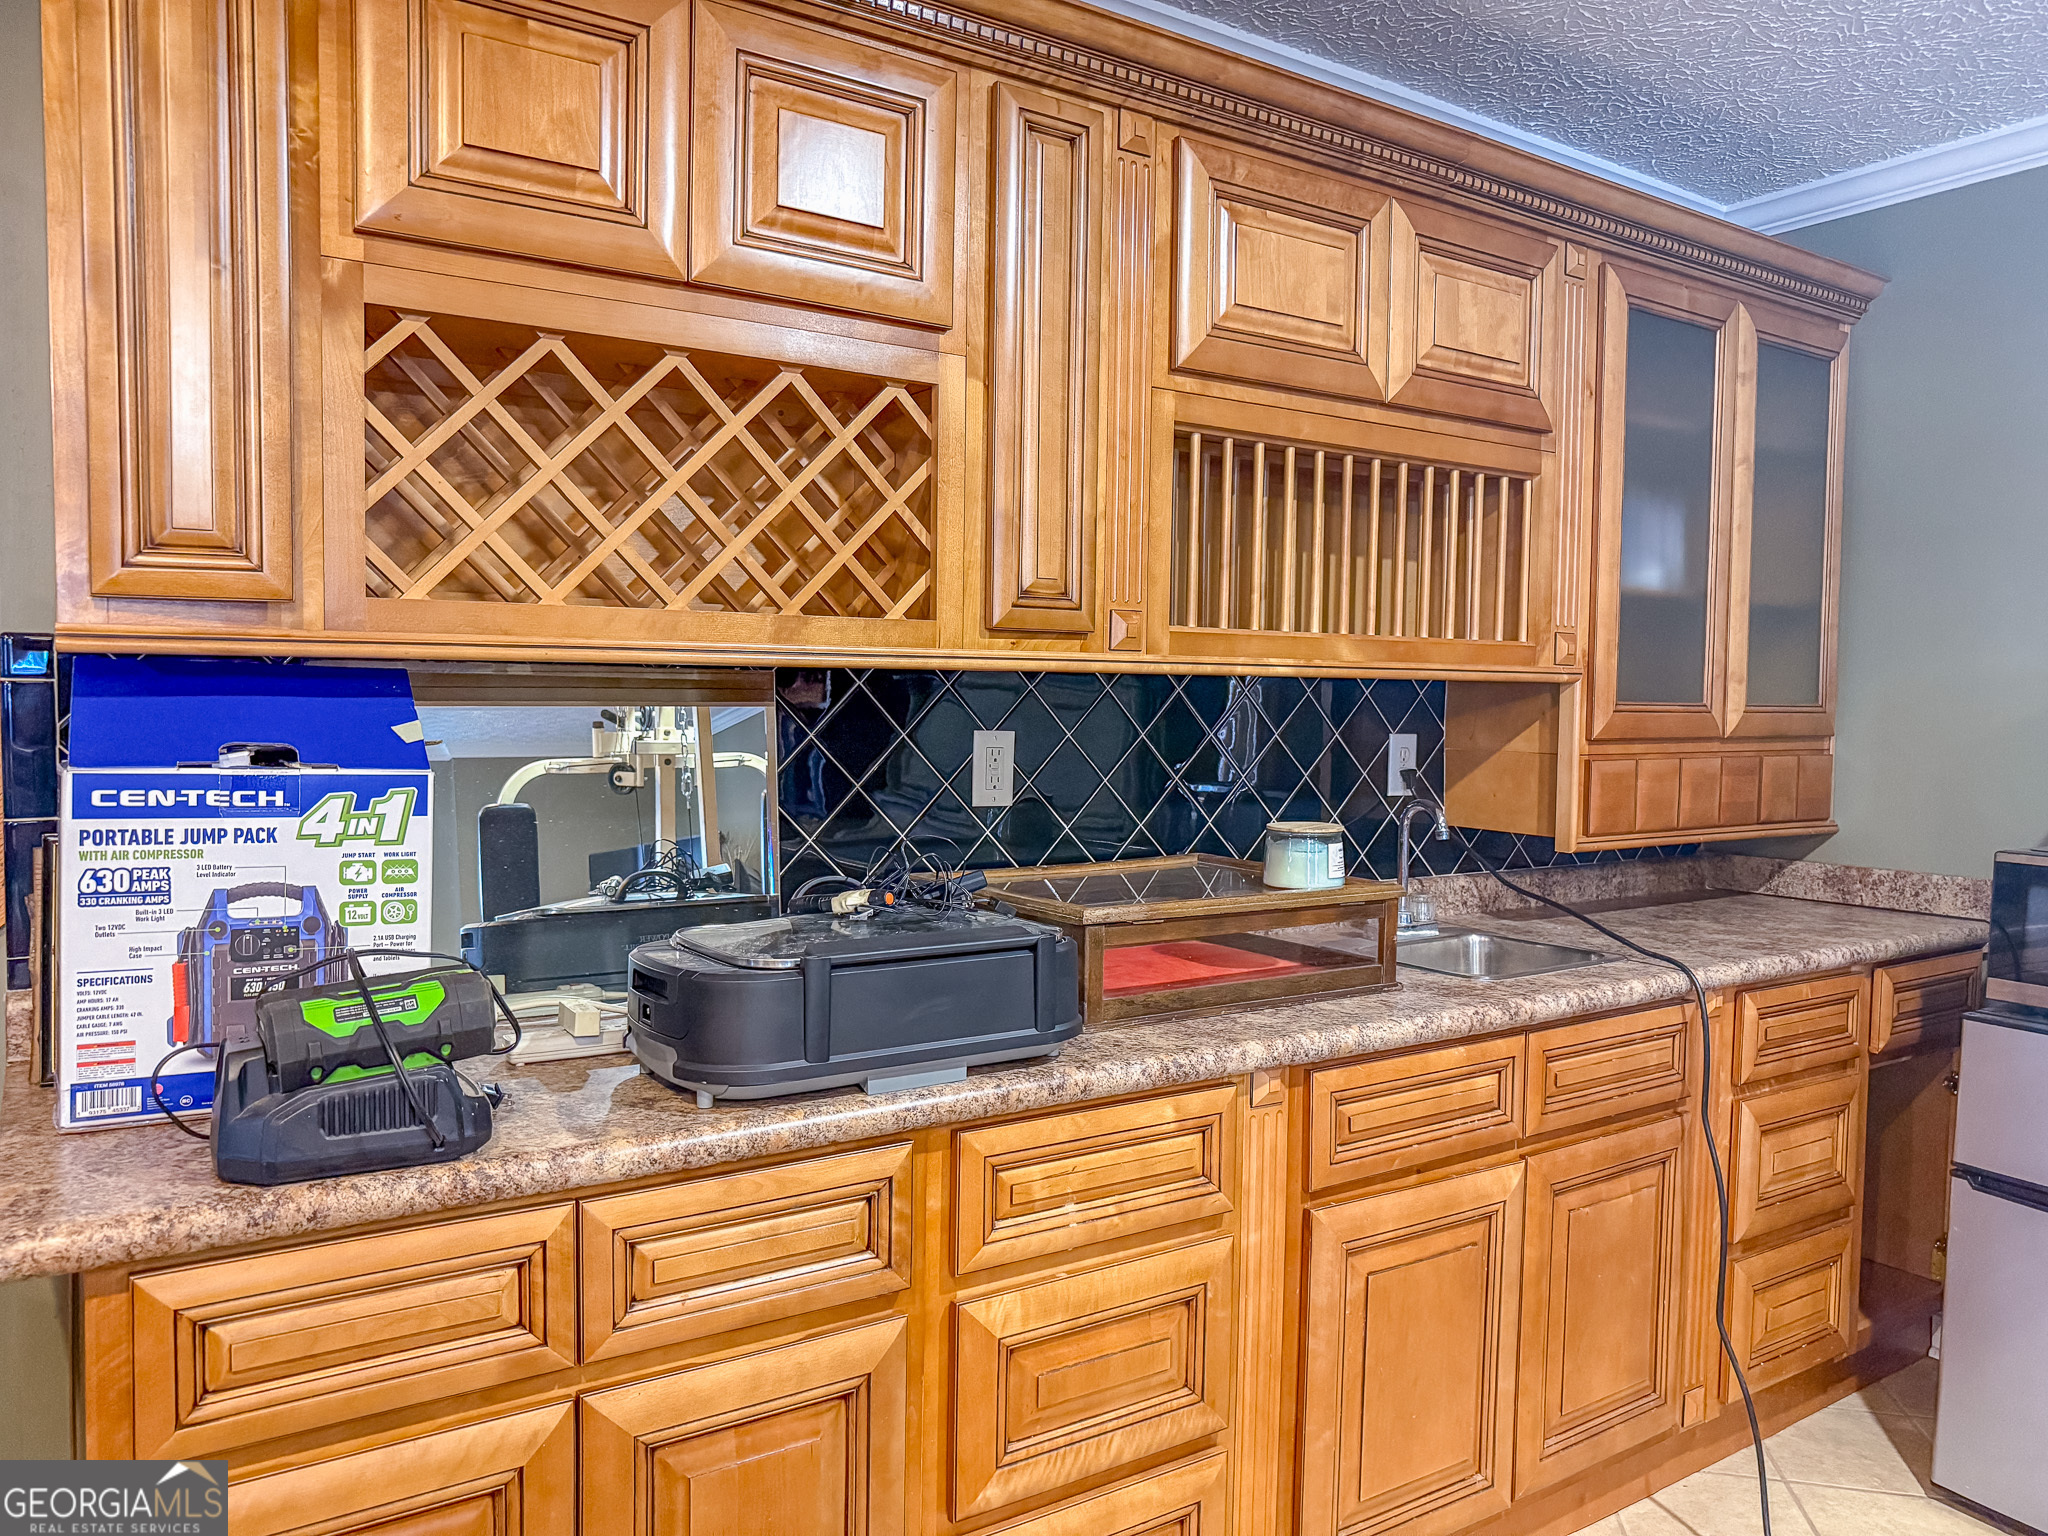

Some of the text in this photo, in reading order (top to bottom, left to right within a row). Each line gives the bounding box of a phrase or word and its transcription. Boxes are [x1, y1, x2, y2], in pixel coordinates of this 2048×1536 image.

[91, 789, 284, 807] CEN-TECH
[79, 827, 278, 846] PORTABLE JUMP PACK
[79, 848, 204, 861] WITH AIR COMPRESSOR
[79, 868, 169, 893] 630 PEAK
[131, 880, 169, 892] AMPS
[80, 895, 170, 906] 330 CRANKING AMPS
[347, 910, 357, 920] 12
[233, 964, 298, 974] CEN-TECH
[76, 974, 153, 988] SPECIFICATIONS
[243, 980, 286, 993] 630 50
